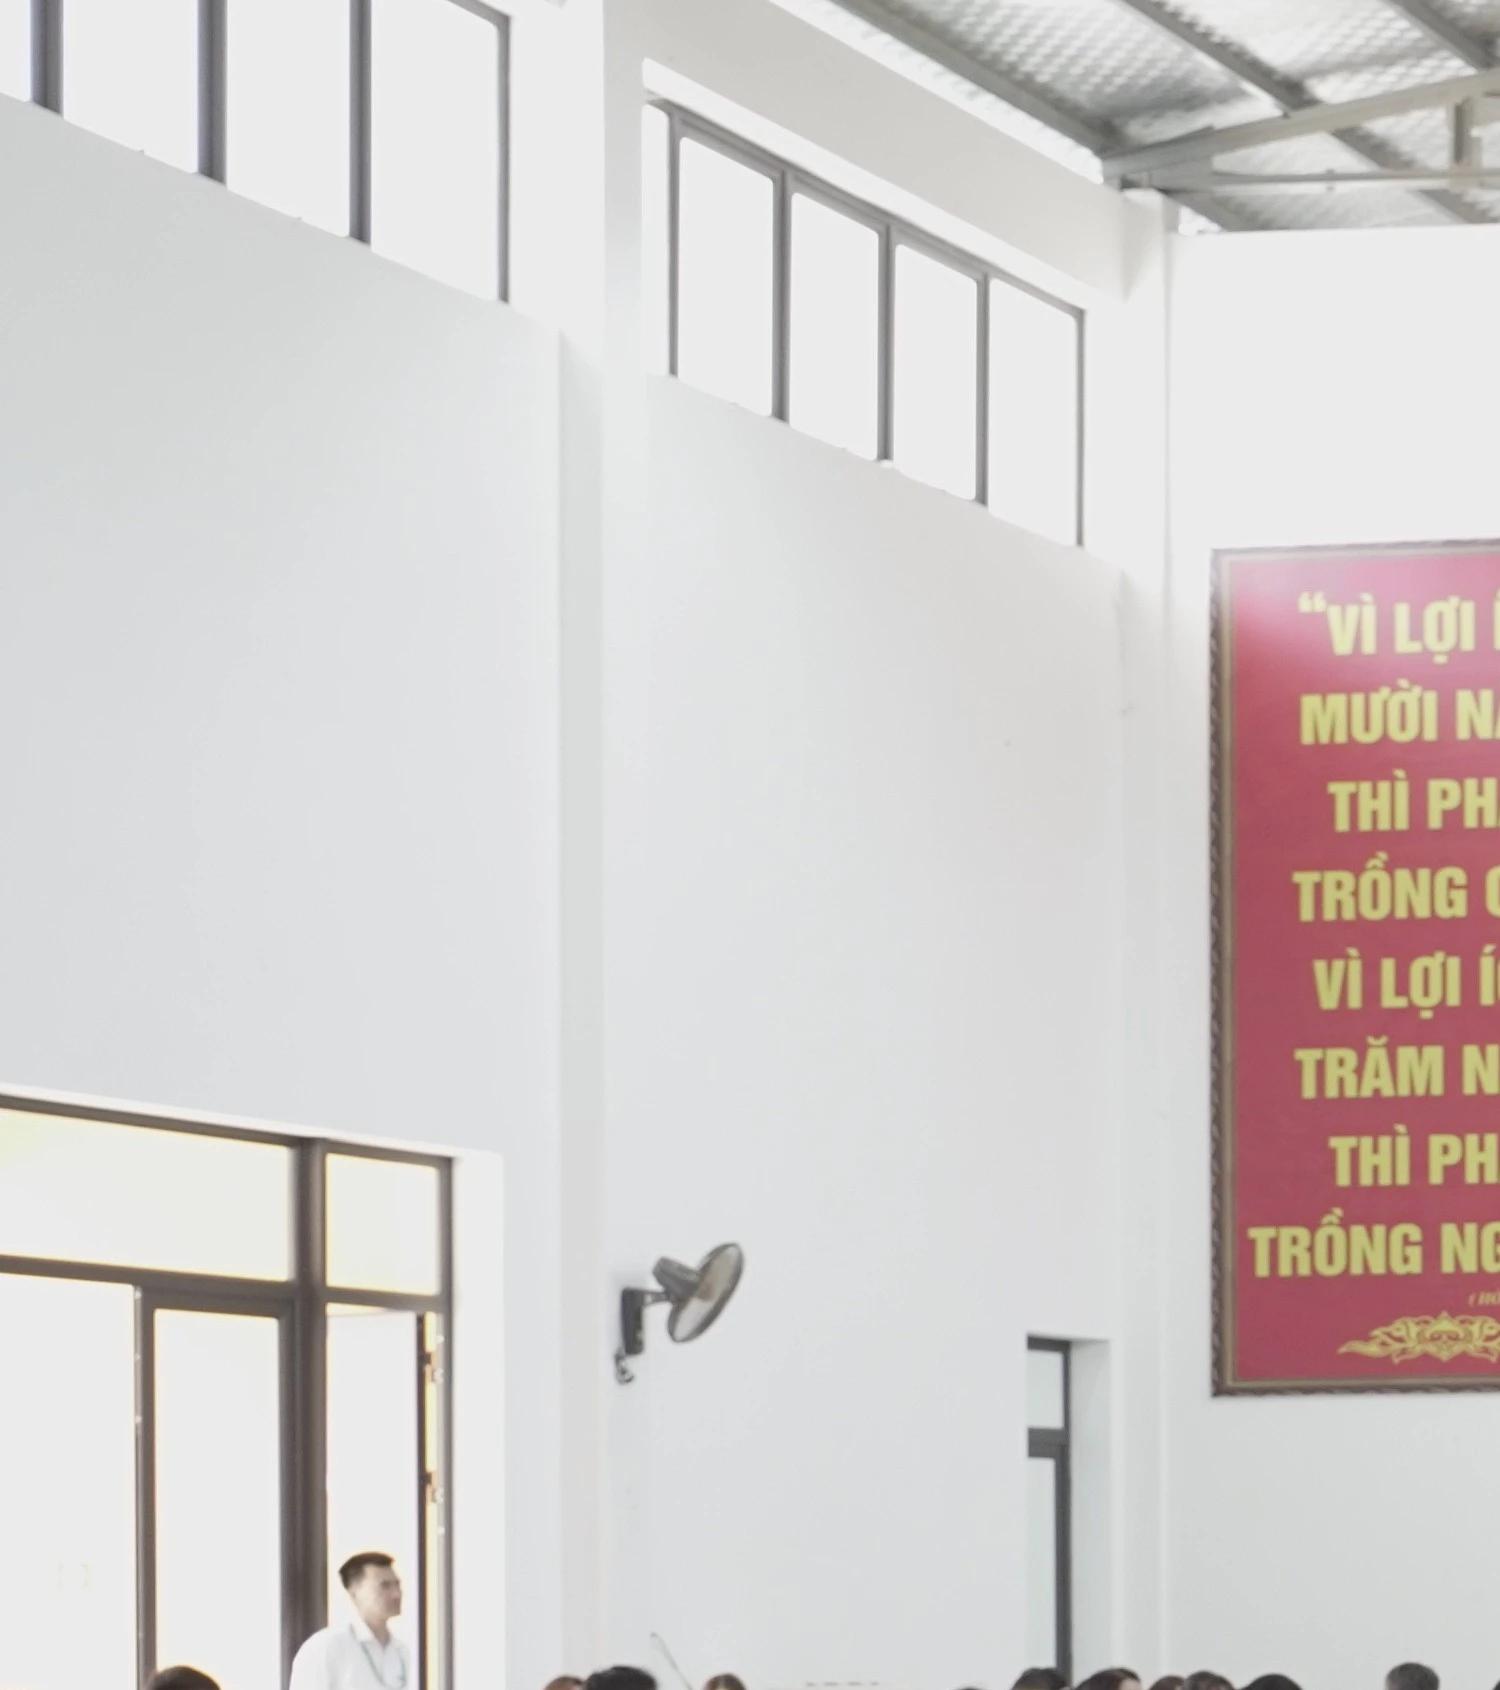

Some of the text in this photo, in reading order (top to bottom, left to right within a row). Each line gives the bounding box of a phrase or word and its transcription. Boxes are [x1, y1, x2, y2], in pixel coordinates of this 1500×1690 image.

[1298, 591, 1379, 657] “VÌ
[1392, 595, 1477, 665] LỢI
[1299, 678, 1441, 745] MƯỜI
[1327, 768, 1411, 833] THÌ
[1291, 851, 1468, 922] TRỒNG
[1313, 947, 1363, 1010] VÌ
[1380, 950, 1461, 1020] LỢI
[1293, 1036, 1444, 1099] TRĂM
[1328, 1124, 1410, 1187] THÌ
[1247, 1207, 1423, 1277] TRỒNG
